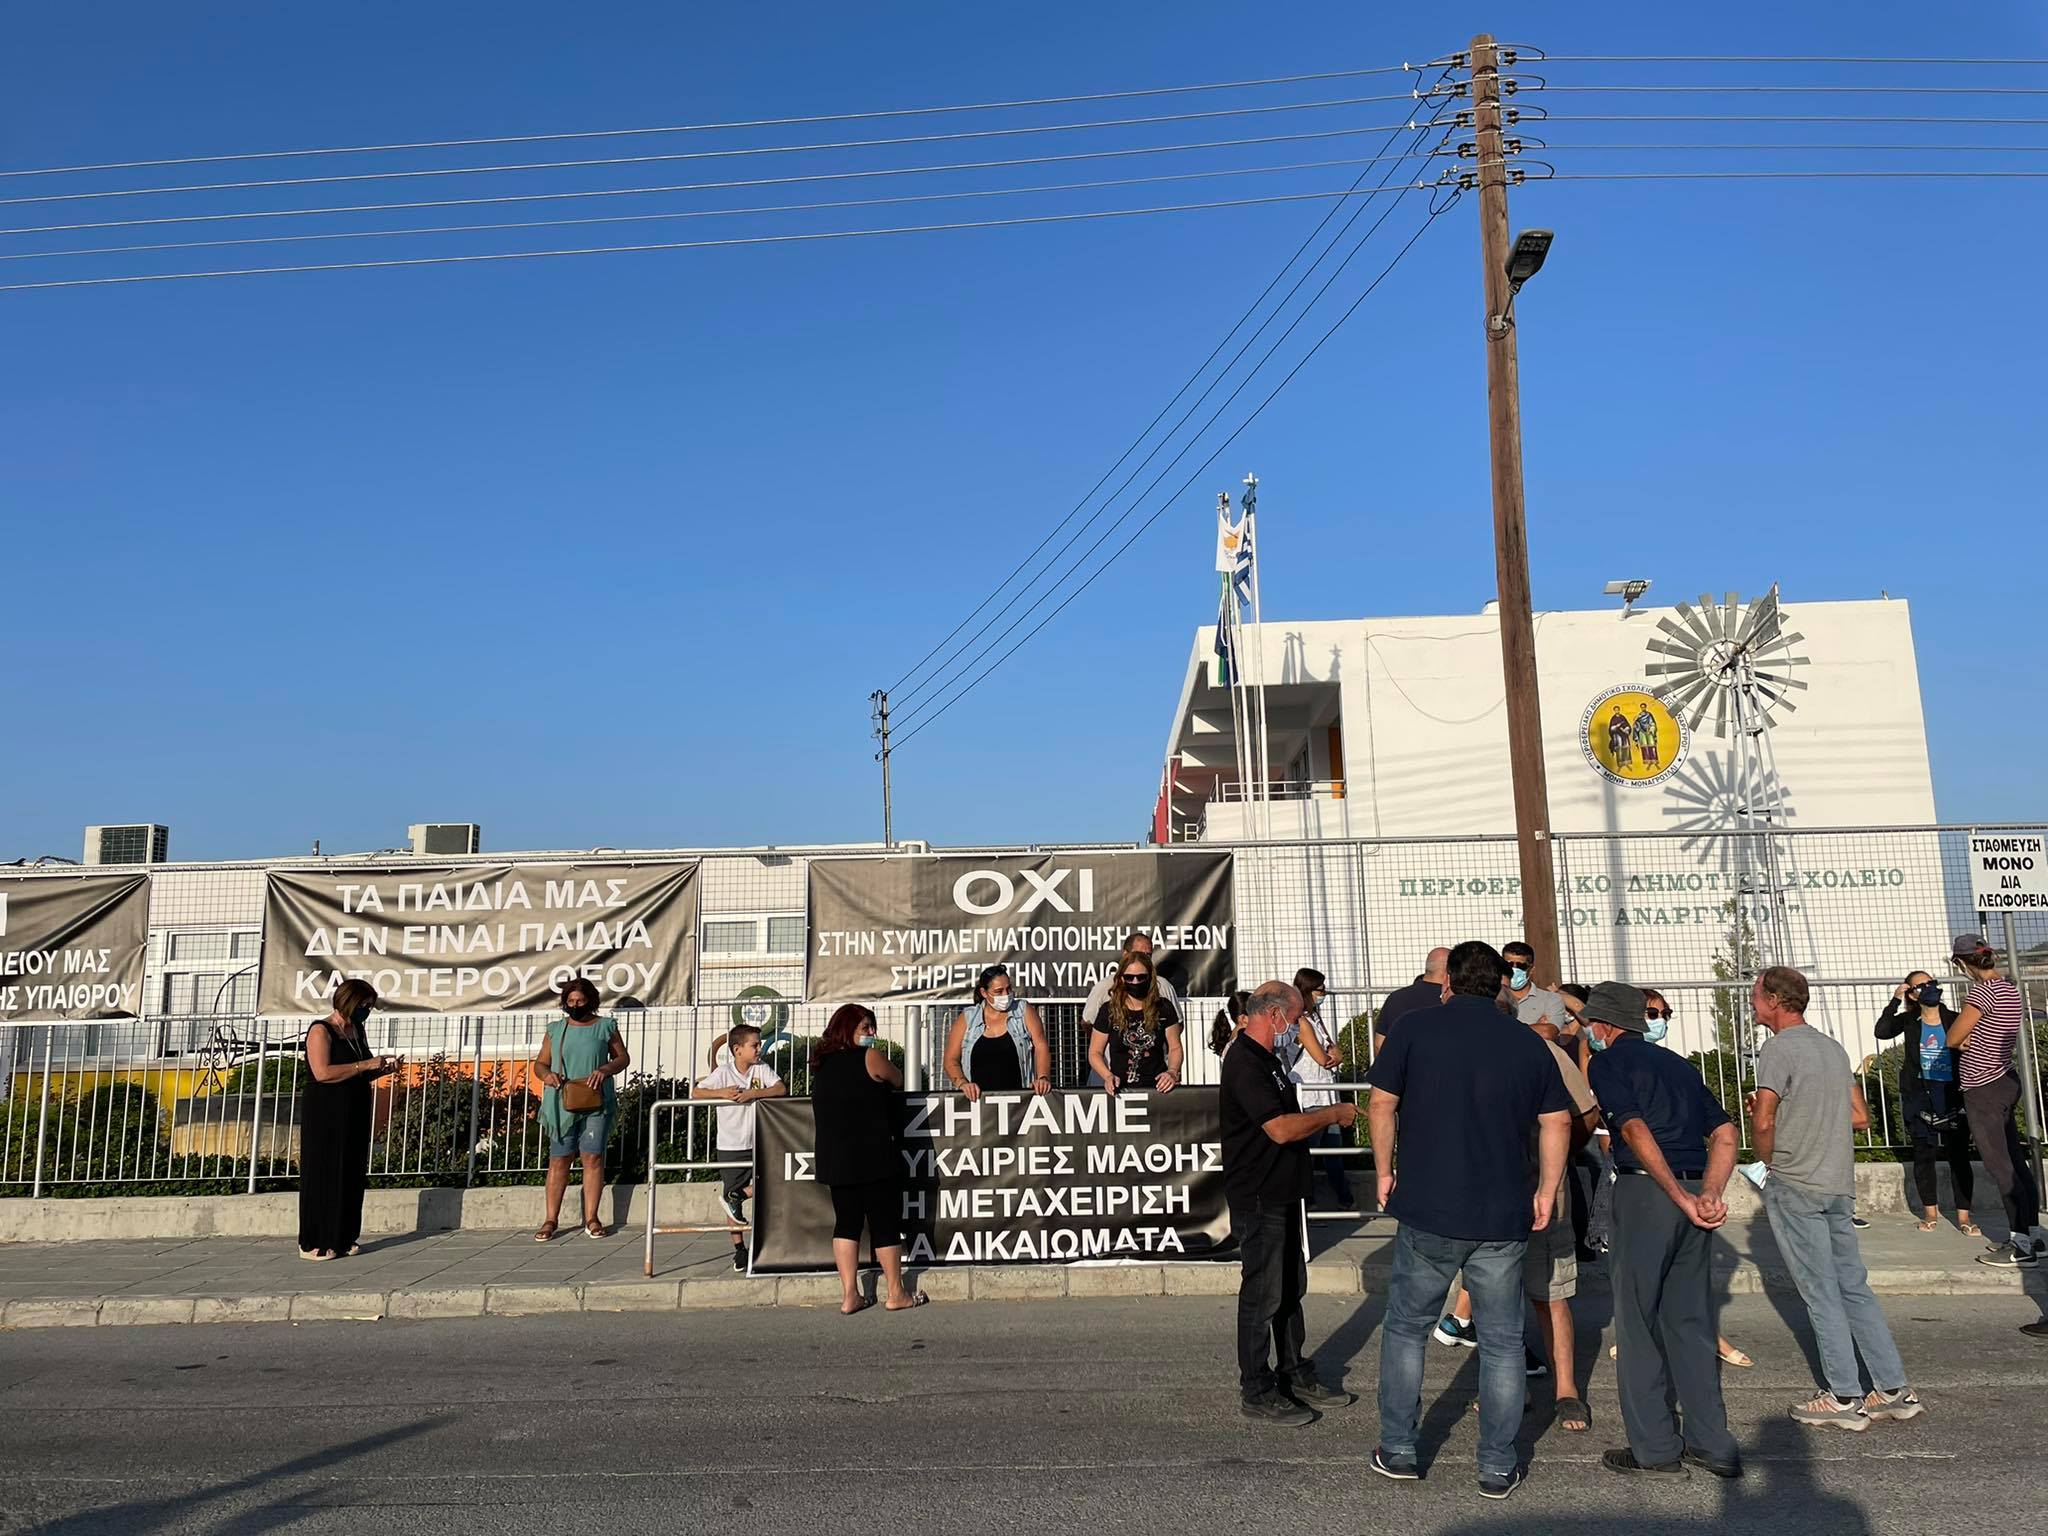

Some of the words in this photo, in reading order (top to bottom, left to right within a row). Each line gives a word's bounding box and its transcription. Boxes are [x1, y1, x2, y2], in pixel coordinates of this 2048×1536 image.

[1590, 686, 1621, 712] ΔΗΜΟΤΙΚΟ
[1603, 771, 1625, 785] ΜΟΝΗ
[1972, 838, 2041, 853] ΣΤΑΘΜΕΥΣΗ
[1982, 856, 2034, 871] ΜΟΝΟ
[336, 884, 385, 914] ΤΑ
[399, 880, 532, 913] ΠΑΙΔΙΑ
[544, 878, 628, 910] ΜΑΣ
[952, 868, 1095, 916] ΟΧΙ
[1399, 874, 1612, 897] ΠΕΡΙΦΕΡΑΚΟ
[1784, 868, 1905, 889] ΣΧΟΛΕΙΟ
[2000, 875, 2022, 889] ΔΙΑ
[1978, 893, 2048, 908] ΛΕΩΦΟΡΕΙΑ
[304, 925, 389, 957] ΔΕΝ
[401, 923, 504, 955] ΕΙΝΑΙ
[518, 919, 654, 953] ΠΑΙΔΙΑ
[817, 929, 876, 957] ΣΤΗΝ
[881, 925, 1131, 956] ΣΥΜΠΛΕΓΜΑΤΟΠΟΙΗΣΗ
[63, 948, 112, 975] ΜΑΣ
[25, 982, 137, 1010] ΥΠΑΙΘΡΟΥ
[903, 1092, 1151, 1138] ΖΗΤΑΜΕ
[784, 1151, 816, 1181] ΙΣ
[901, 1146, 1075, 1178] ΥΚΑΙΡΙΕΣ
[1086, 1143, 1224, 1175] ΜΑΘΗΣ
[939, 1185, 1190, 1220] ΜΕΤΑΧΕΙΡΙΣΗ
[944, 1226, 1186, 1262] ΔΙΚΑΙΩΜΑΤΑ
